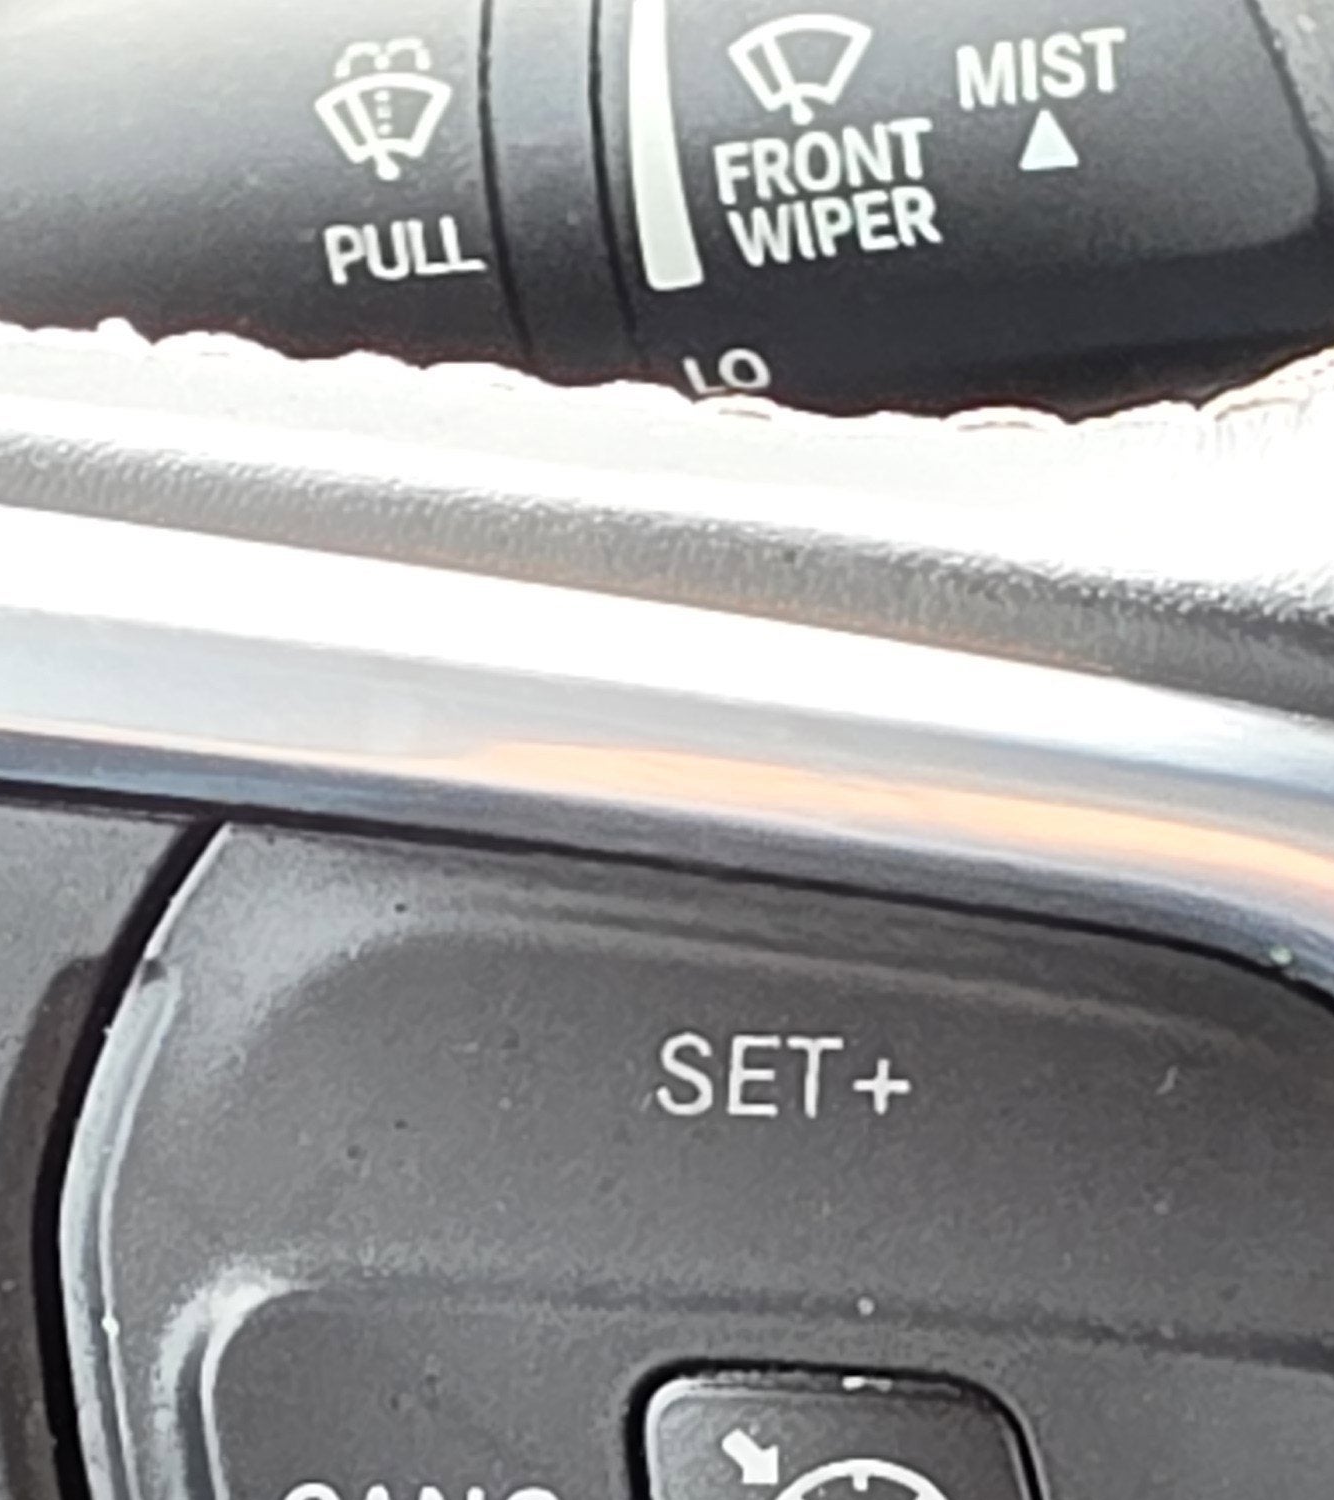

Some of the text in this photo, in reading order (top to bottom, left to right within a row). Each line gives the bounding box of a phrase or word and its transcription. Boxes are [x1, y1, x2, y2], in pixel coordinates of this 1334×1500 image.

[955, 28, 1126, 110] MIST
[713, 118, 933, 206] FRONT
[324, 216, 487, 285] PULL
[727, 188, 944, 267] WIPER
[682, 348, 771, 394] LO
